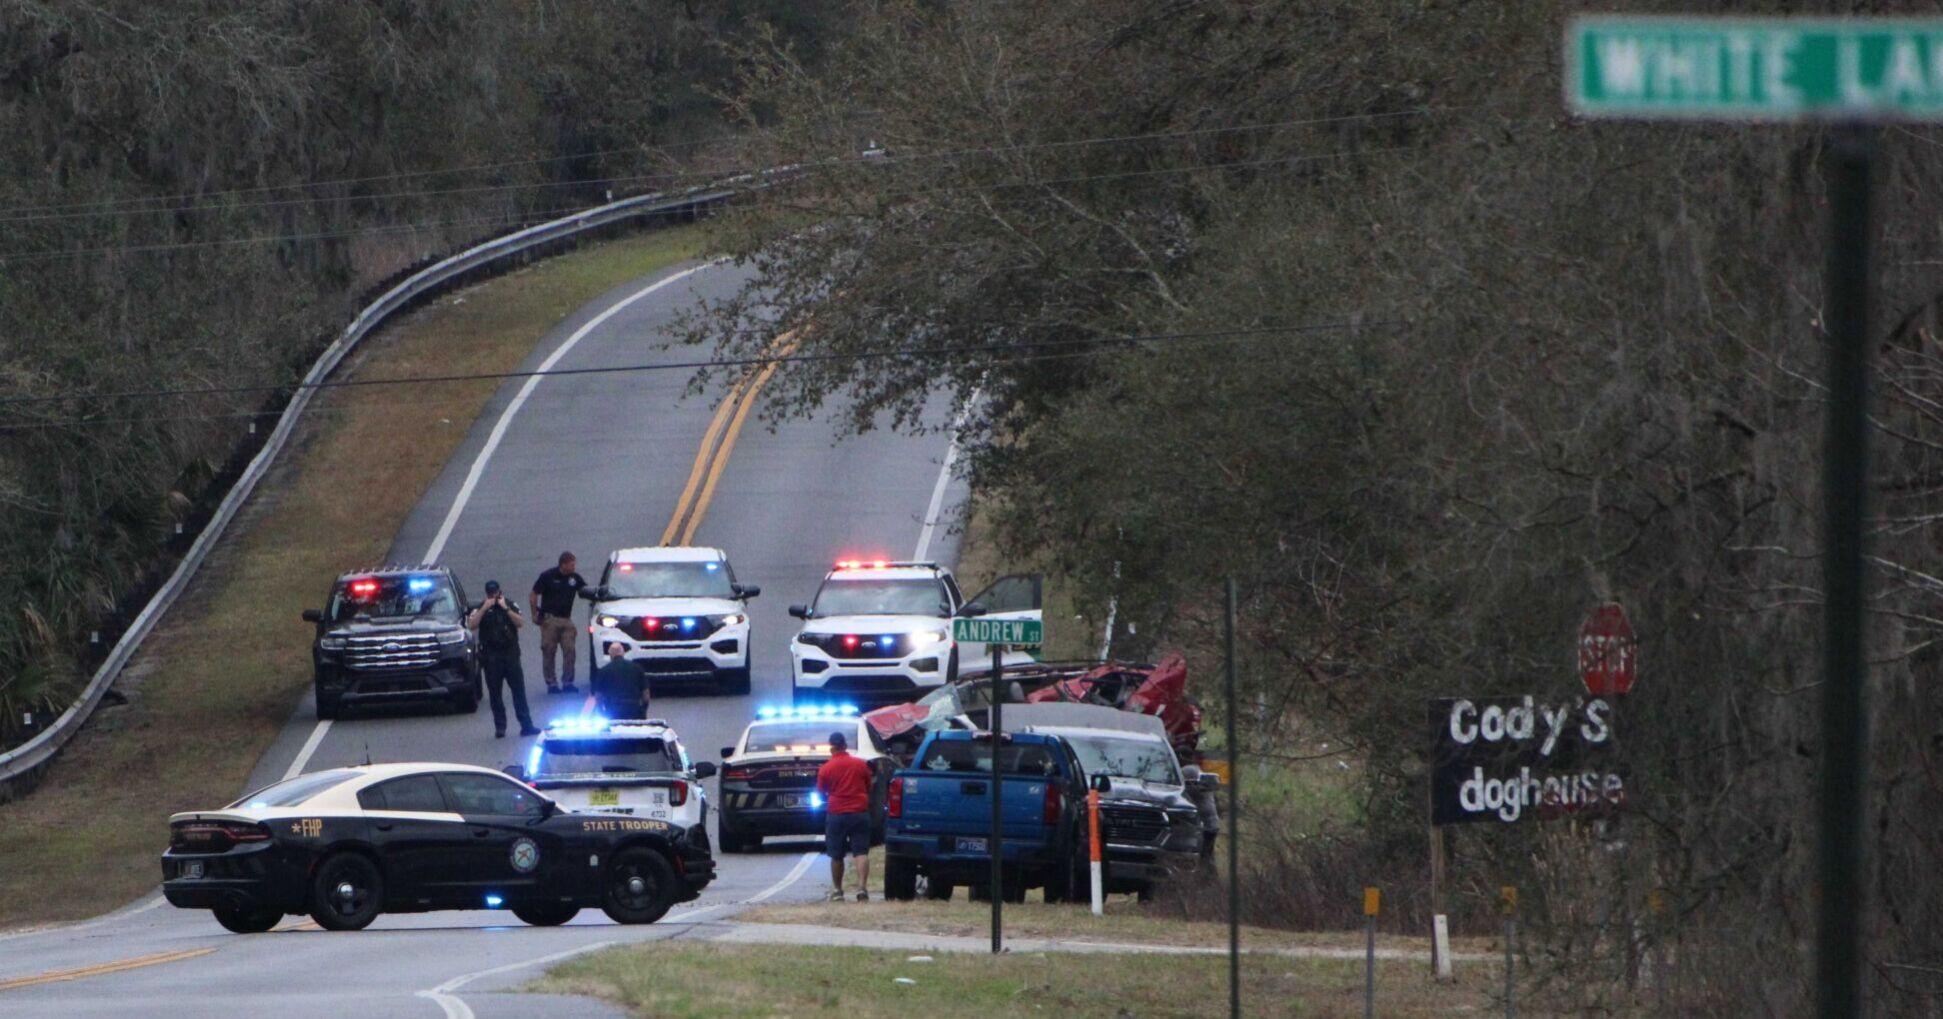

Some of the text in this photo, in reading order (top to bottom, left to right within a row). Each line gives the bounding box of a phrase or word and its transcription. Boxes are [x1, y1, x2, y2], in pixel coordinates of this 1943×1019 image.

[1597, 36, 1804, 102] WHITE
[958, 621, 1024, 641] ANDREW
[1460, 766, 1624, 822] doghouse
[302, 818, 323, 837] FHP
[583, 820, 669, 831] STATE TROOPER
